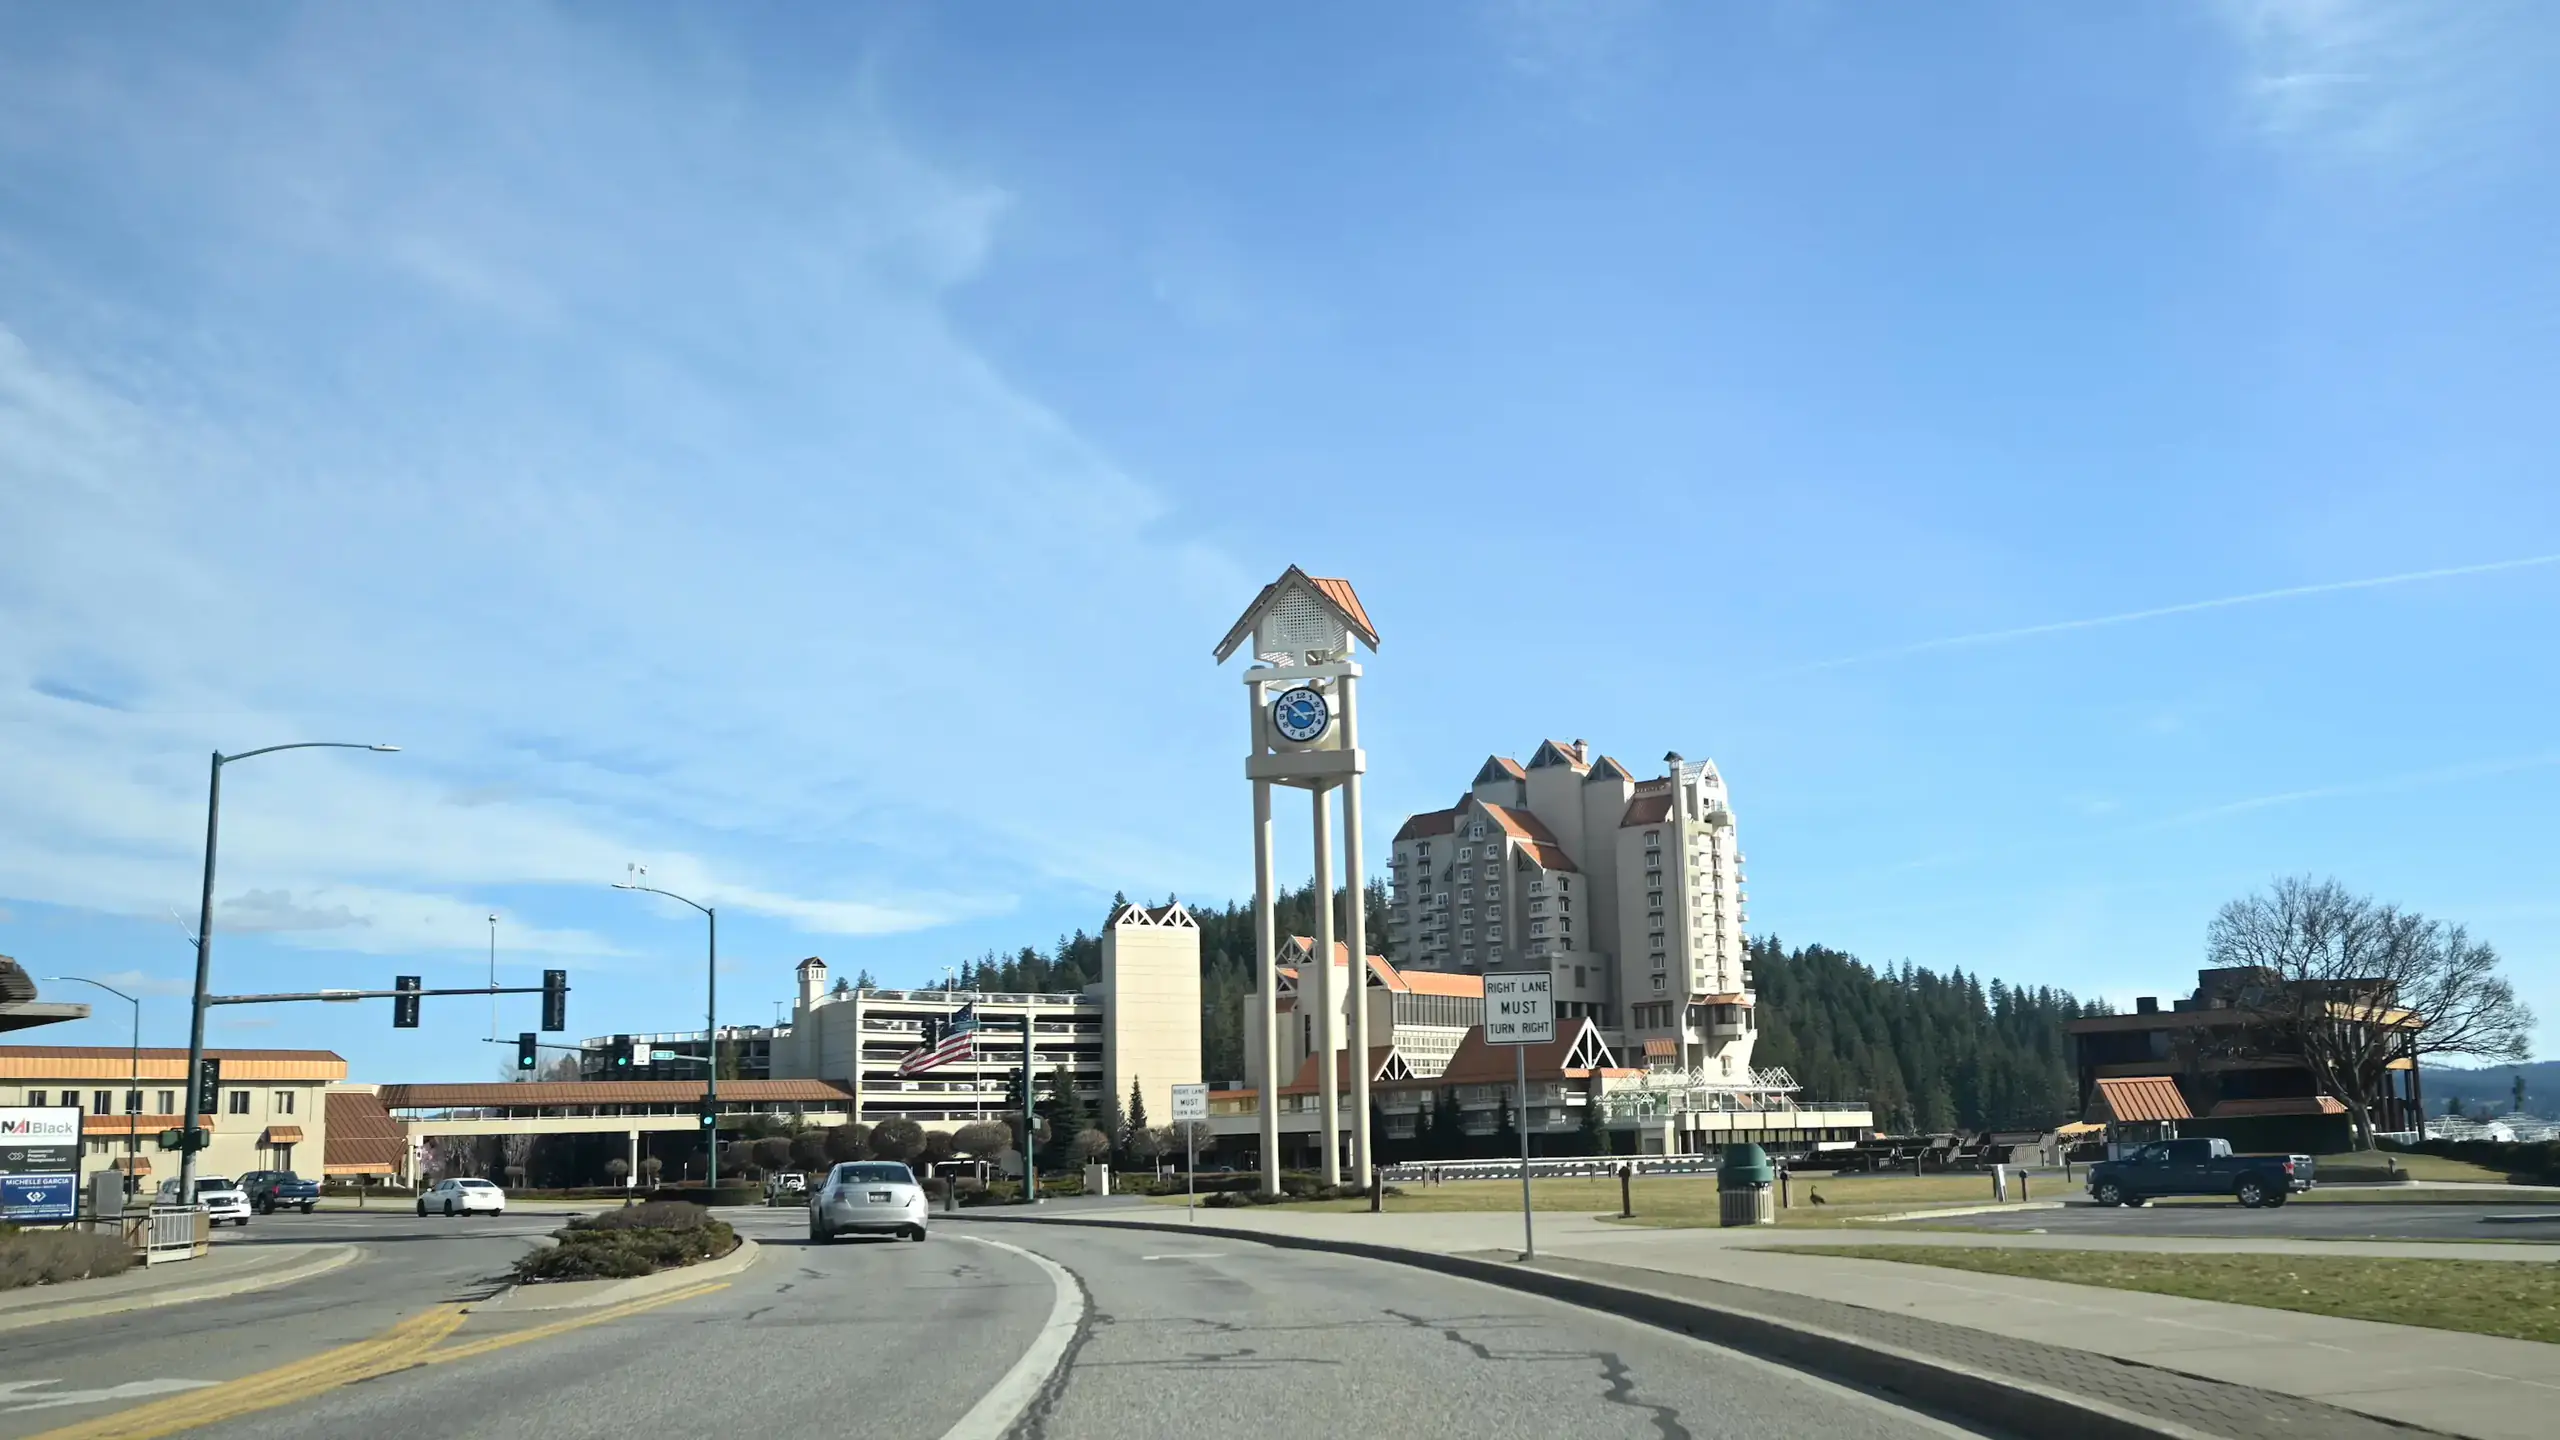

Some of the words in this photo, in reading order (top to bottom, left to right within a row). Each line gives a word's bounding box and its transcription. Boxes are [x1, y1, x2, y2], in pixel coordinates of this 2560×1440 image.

[1487, 982, 1516, 994] RIGHT
[1521, 981, 1548, 992] LANE
[1501, 1000, 1537, 1015] MUST
[1489, 1023, 1515, 1035] TURN
[1522, 1021, 1549, 1033] RIGHT
[1, 1118, 30, 1134] NAI
[32, 1122, 73, 1134] Black
